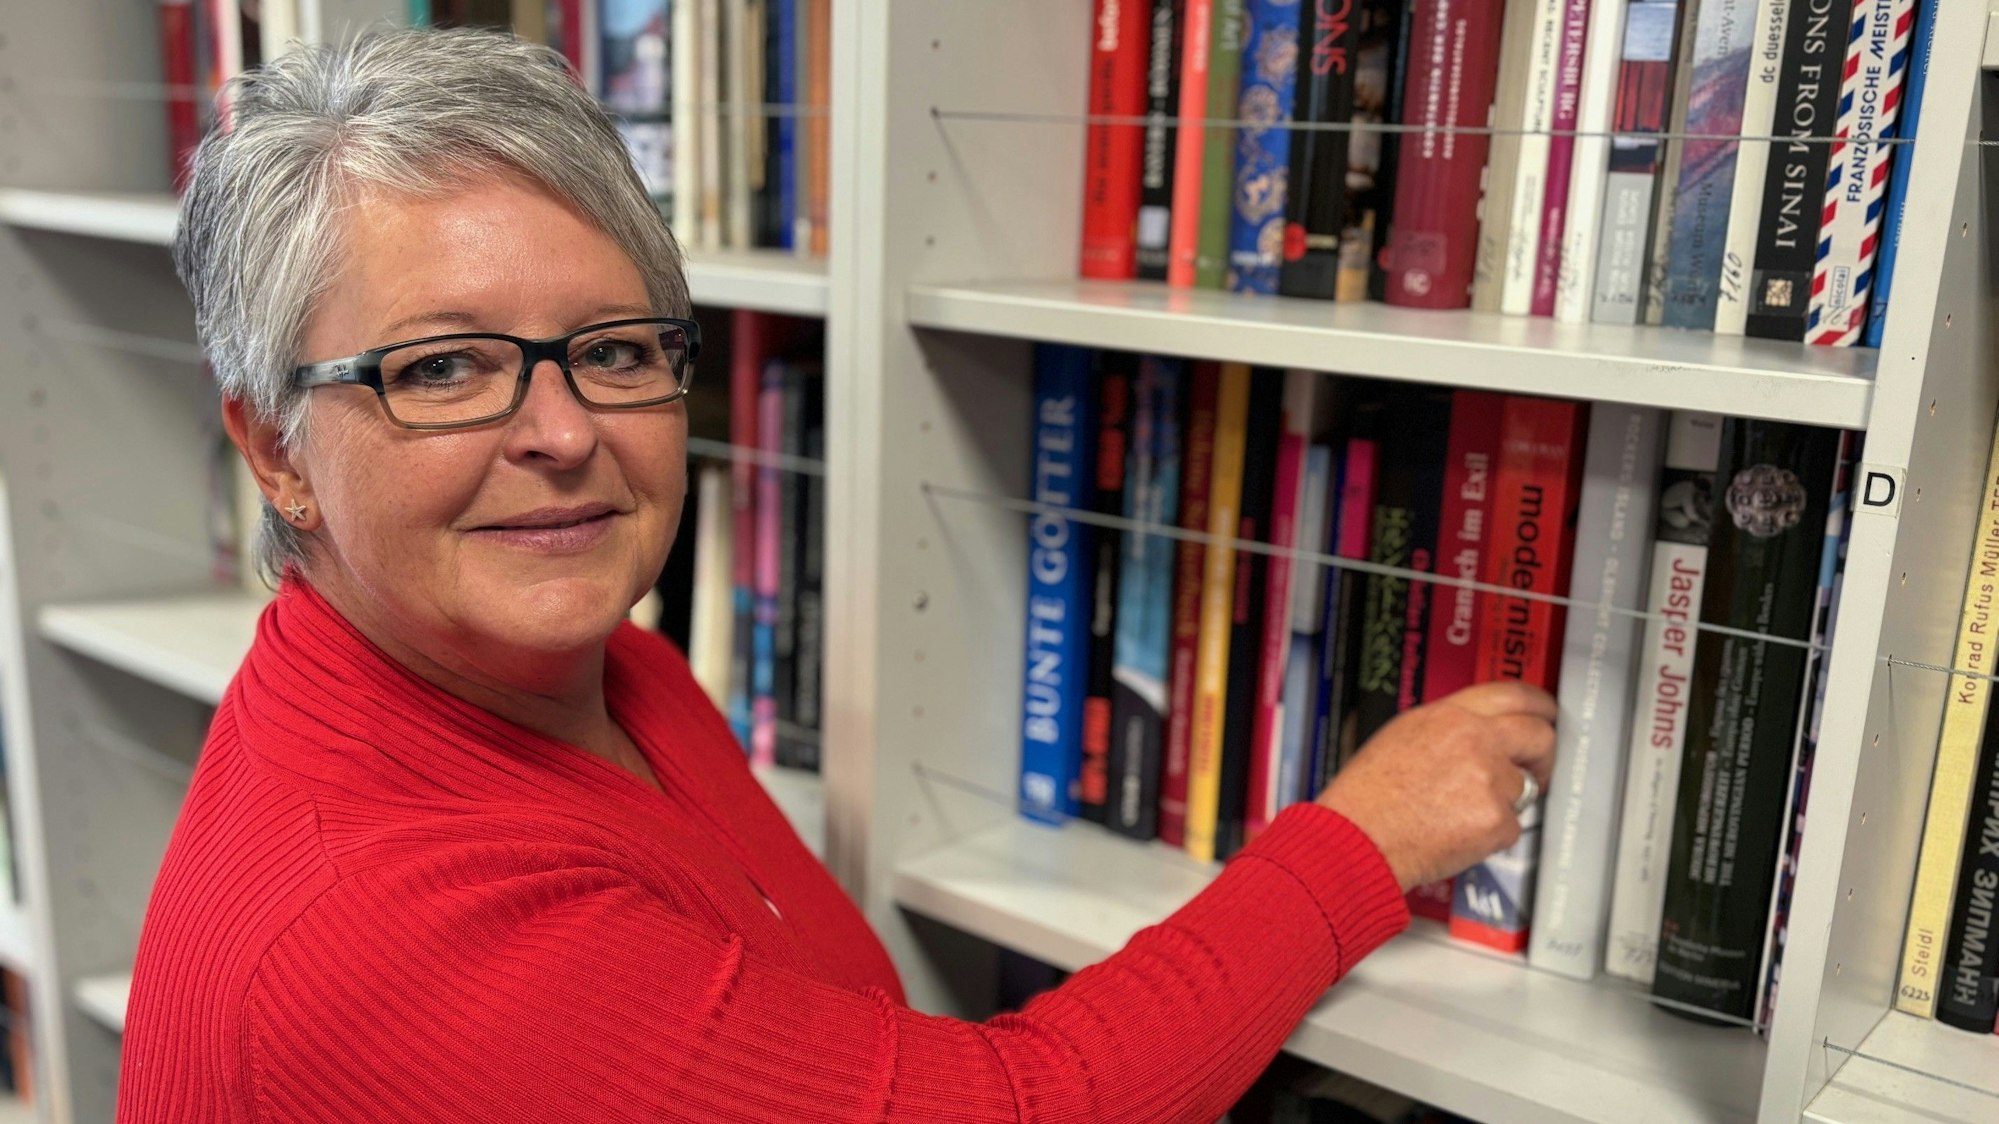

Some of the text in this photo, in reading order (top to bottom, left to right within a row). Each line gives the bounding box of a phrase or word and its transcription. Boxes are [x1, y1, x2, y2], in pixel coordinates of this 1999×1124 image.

[1762, 0, 1788, 84] dc duessel
[1790, 63, 1823, 154] FROM
[1846, 0, 1894, 203] FRANZÖSISCHE MEIST
[1691, 182, 1714, 249] Museum
[1775, 163, 1808, 249] SINAI
[1834, 267, 1848, 305] nicolai
[1461, 452, 1489, 502] Exil
[1863, 472, 1896, 507] D
[1457, 508, 1483, 541] im
[1659, 558, 1700, 657] Jasper
[1969, 583, 1994, 635] Rufus
[1025, 594, 1067, 745] BUNTE
[1651, 664, 1687, 751] Johns
[1911, 928, 1933, 978] Steidl
